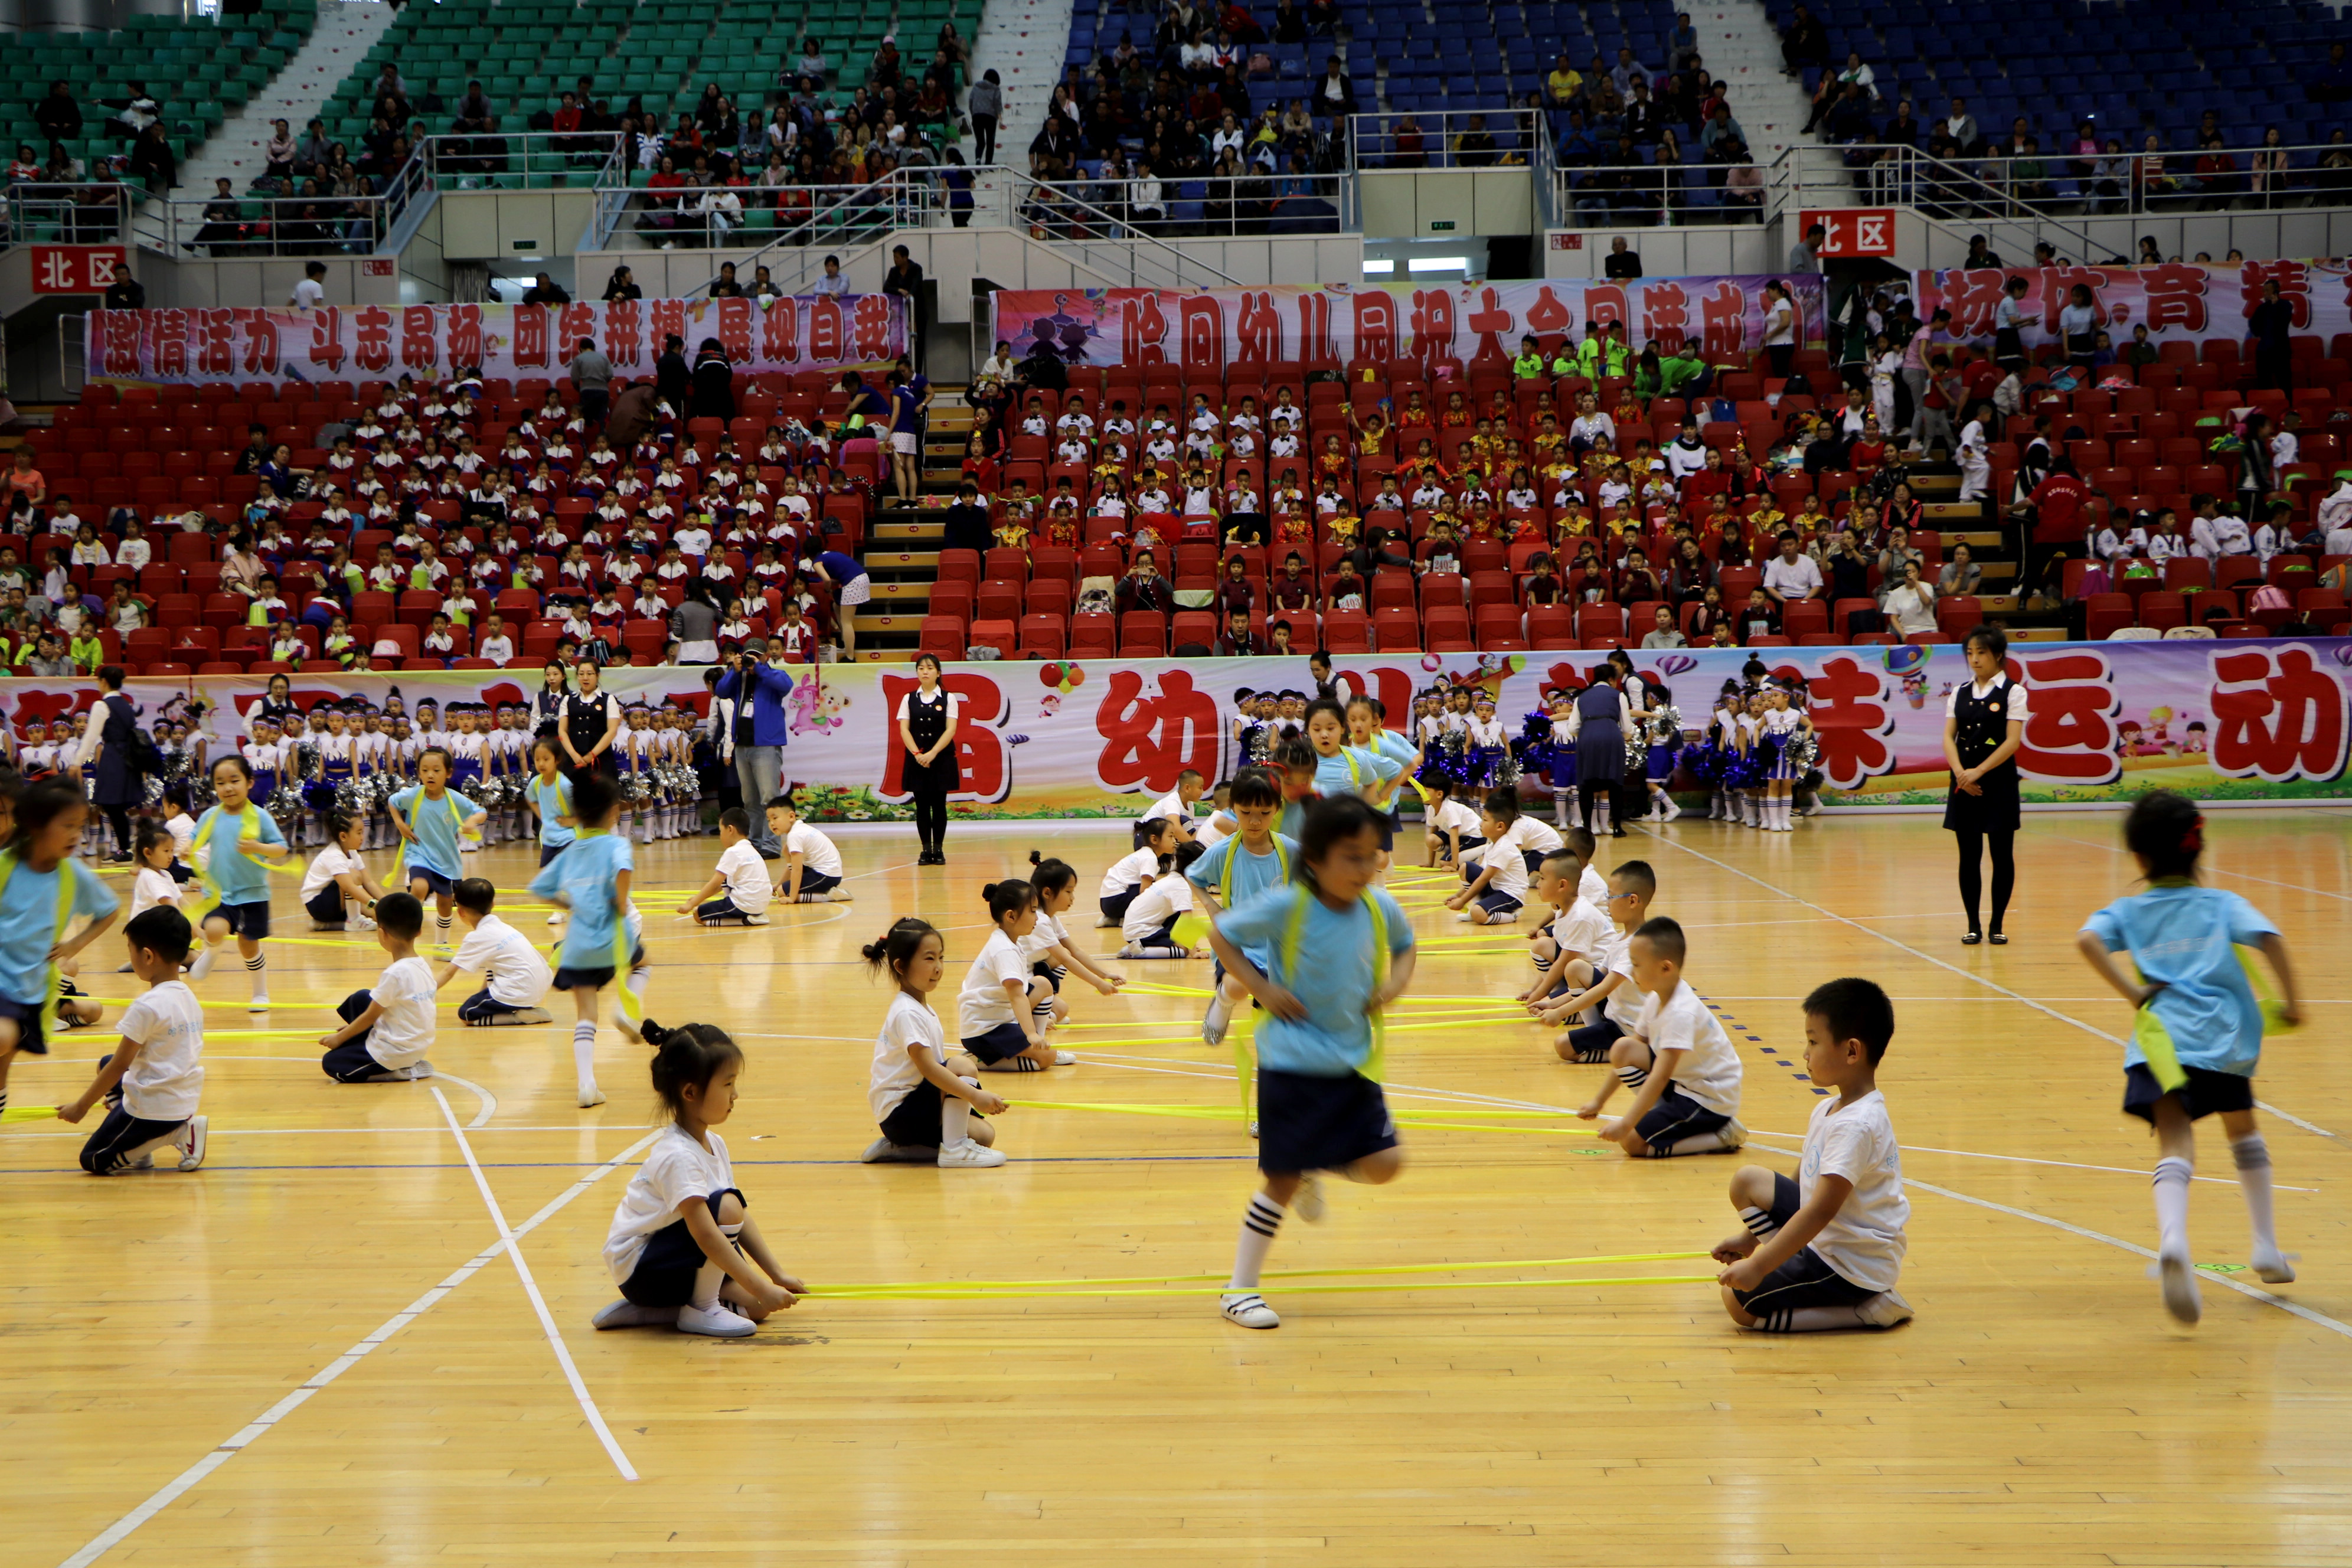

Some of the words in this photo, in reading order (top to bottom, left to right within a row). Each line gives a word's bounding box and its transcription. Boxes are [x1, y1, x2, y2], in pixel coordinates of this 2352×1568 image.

[1815, 215, 1889, 253] 北区
[41, 251, 116, 289] 北区
[1942, 258, 2352, 337] 扬体育精
[104, 307, 280, 376] 激情活力
[309, 303, 483, 373] 斗志昂扬
[512, 297, 688, 369] 团结拼搏
[717, 292, 892, 364] 展现自我
